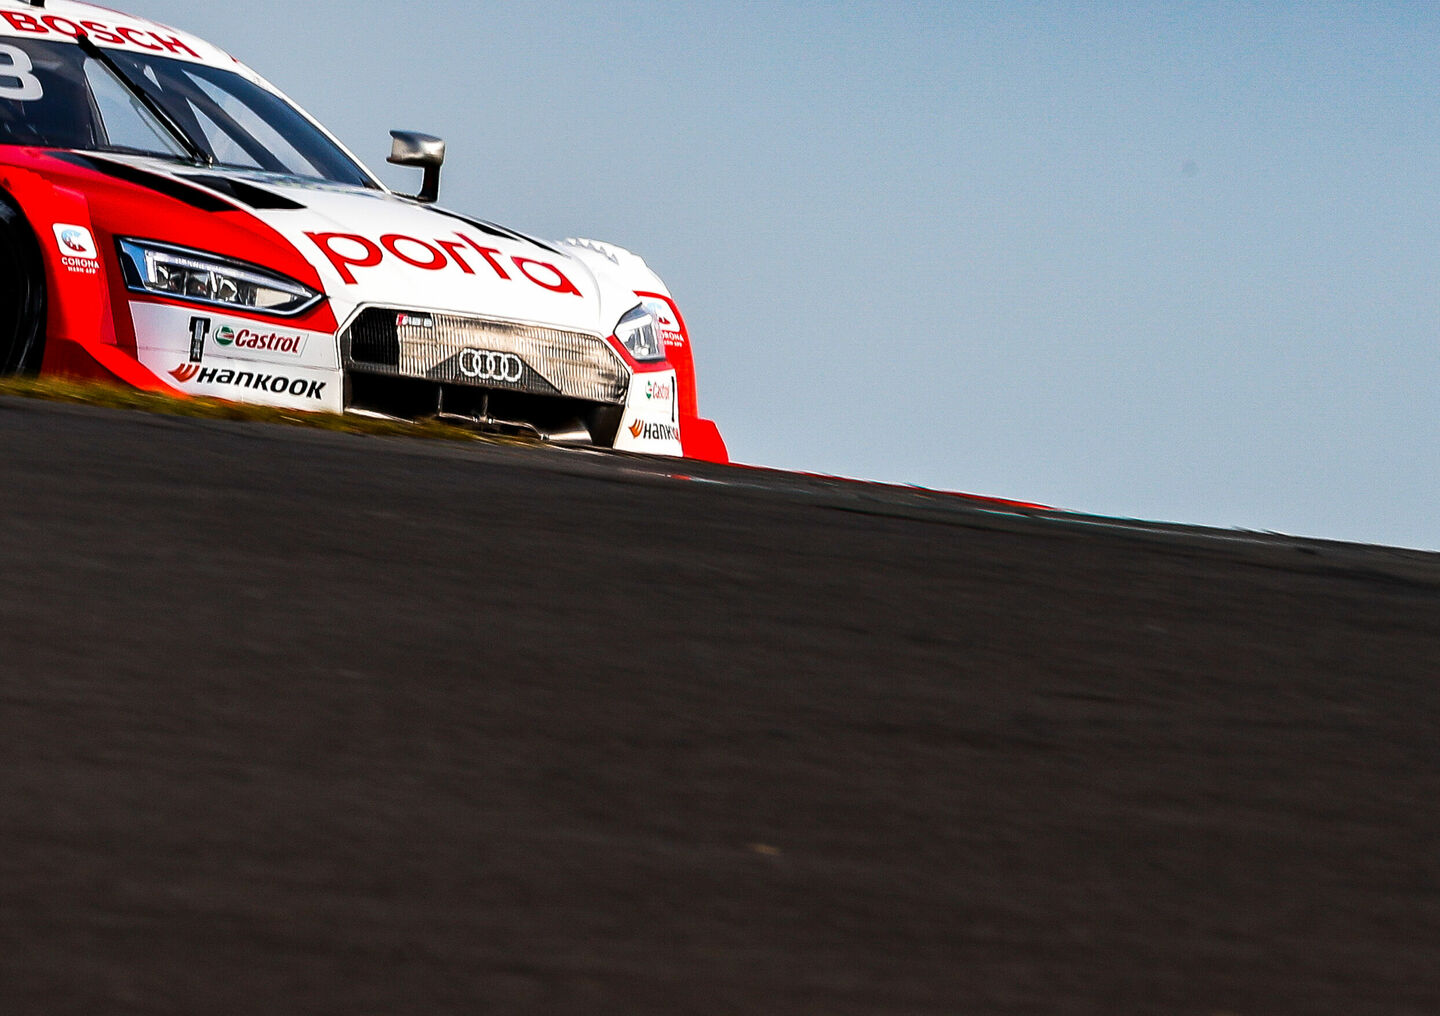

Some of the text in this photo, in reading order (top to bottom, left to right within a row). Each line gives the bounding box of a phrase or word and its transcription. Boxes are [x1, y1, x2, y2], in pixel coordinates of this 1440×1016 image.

[61, 256, 100, 269] CORONA
[302, 230, 584, 298] porta
[235, 328, 301, 354] Castrol
